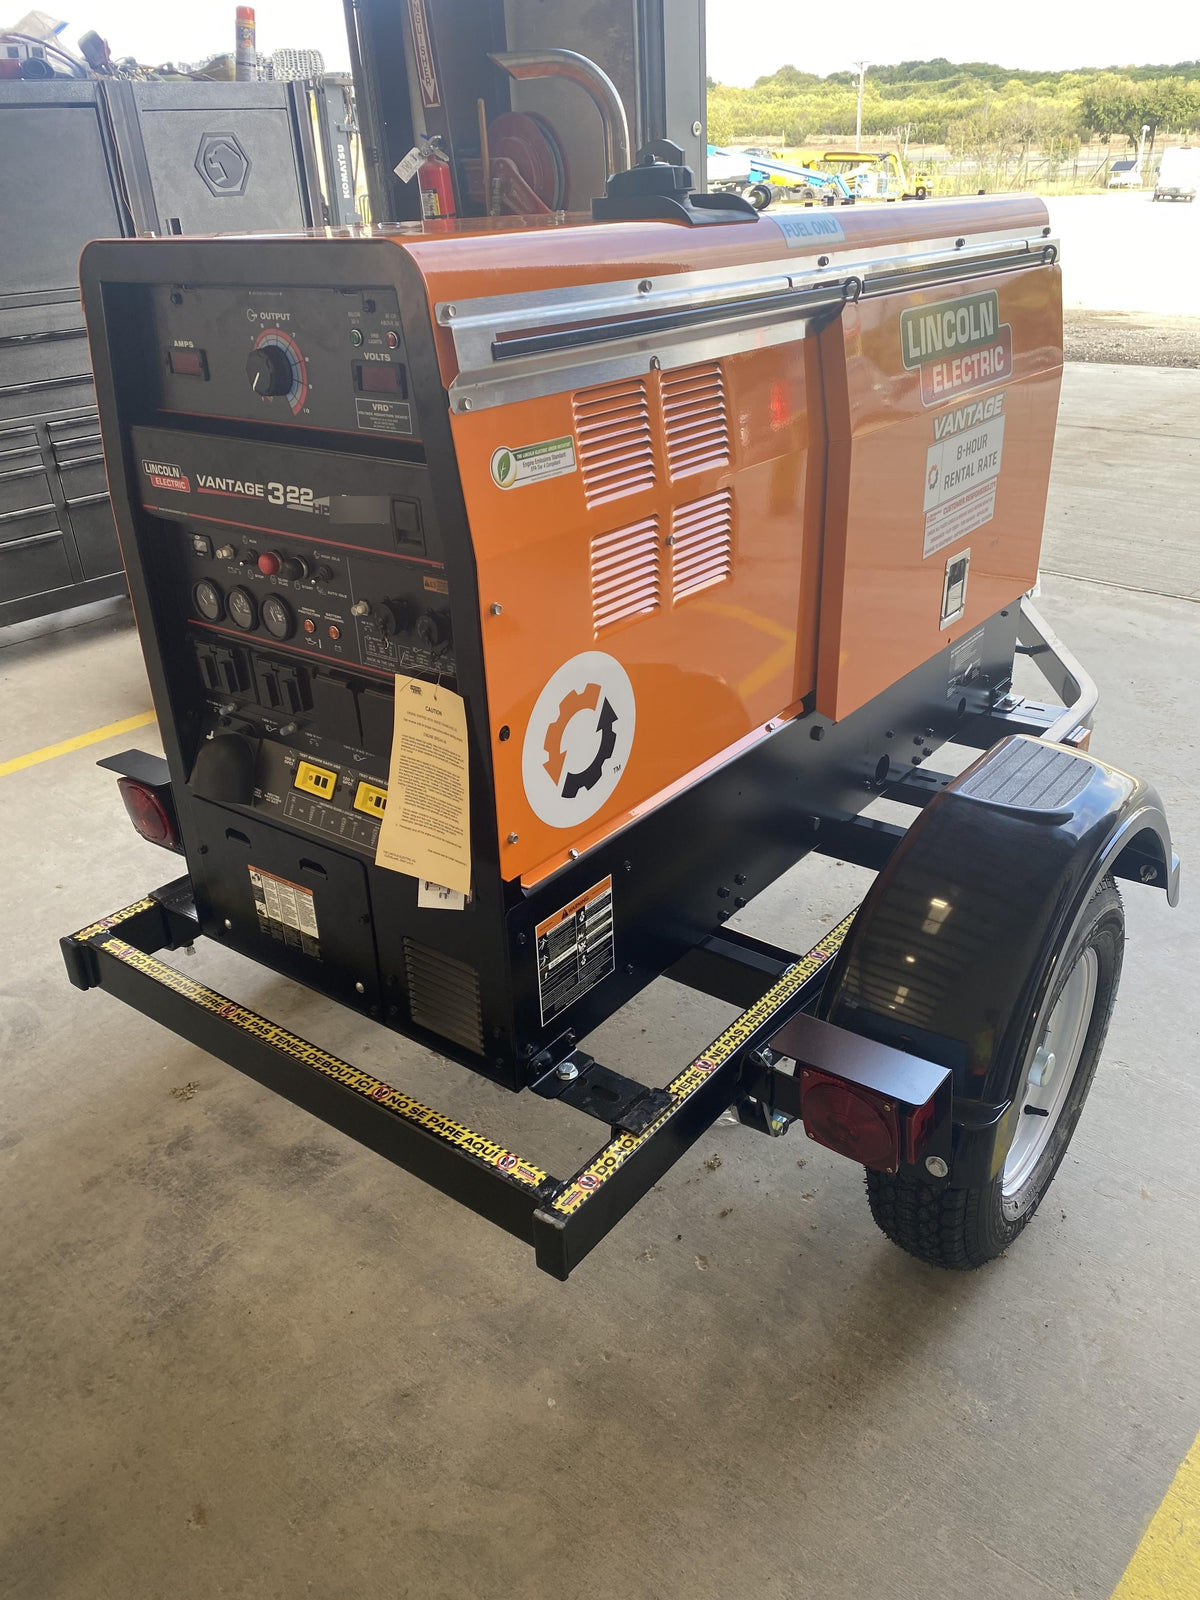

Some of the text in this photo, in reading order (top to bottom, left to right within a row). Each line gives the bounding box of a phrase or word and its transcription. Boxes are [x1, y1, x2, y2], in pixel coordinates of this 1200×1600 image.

[413, 0, 431, 87] NGUISHER
[337, 144, 350, 199] KOMATSU
[783, 219, 838, 238] FUEL ONLY
[260, 311, 290, 321] OUTPUT
[907, 300, 994, 358] LINCOLN
[174, 340, 194, 348] AMPS
[364, 352, 391, 361] VOLTS
[932, 345, 1004, 393] ELECTRIC
[933, 392, 1004, 440] VANTAGE
[956, 433, 988, 461] 8-HOUR
[144, 462, 180, 478] LINCOLN
[155, 477, 186, 489] ELECTRIC
[943, 451, 998, 490] RENTAL RATE
[196, 474, 313, 506] VANTAGE 322
[425, 705, 442, 716] CAUTION
[613, 764, 622, 774] TM
[568, 895, 589, 912] WARNING
[821, 930, 846, 953] NO SE
[129, 954, 223, 1010] DO NOT STAND HERE
[712, 959, 816, 1060] NE PAS TENEZ DEBOUT ICI
[234, 1012, 374, 1090] NE PAS TENEZ DEBOUT ICI
[387, 1094, 410, 1109] NO
[407, 1105, 428, 1119] SE
[426, 1116, 465, 1139] PARE
[595, 1070, 702, 1175] DO NO HERE
